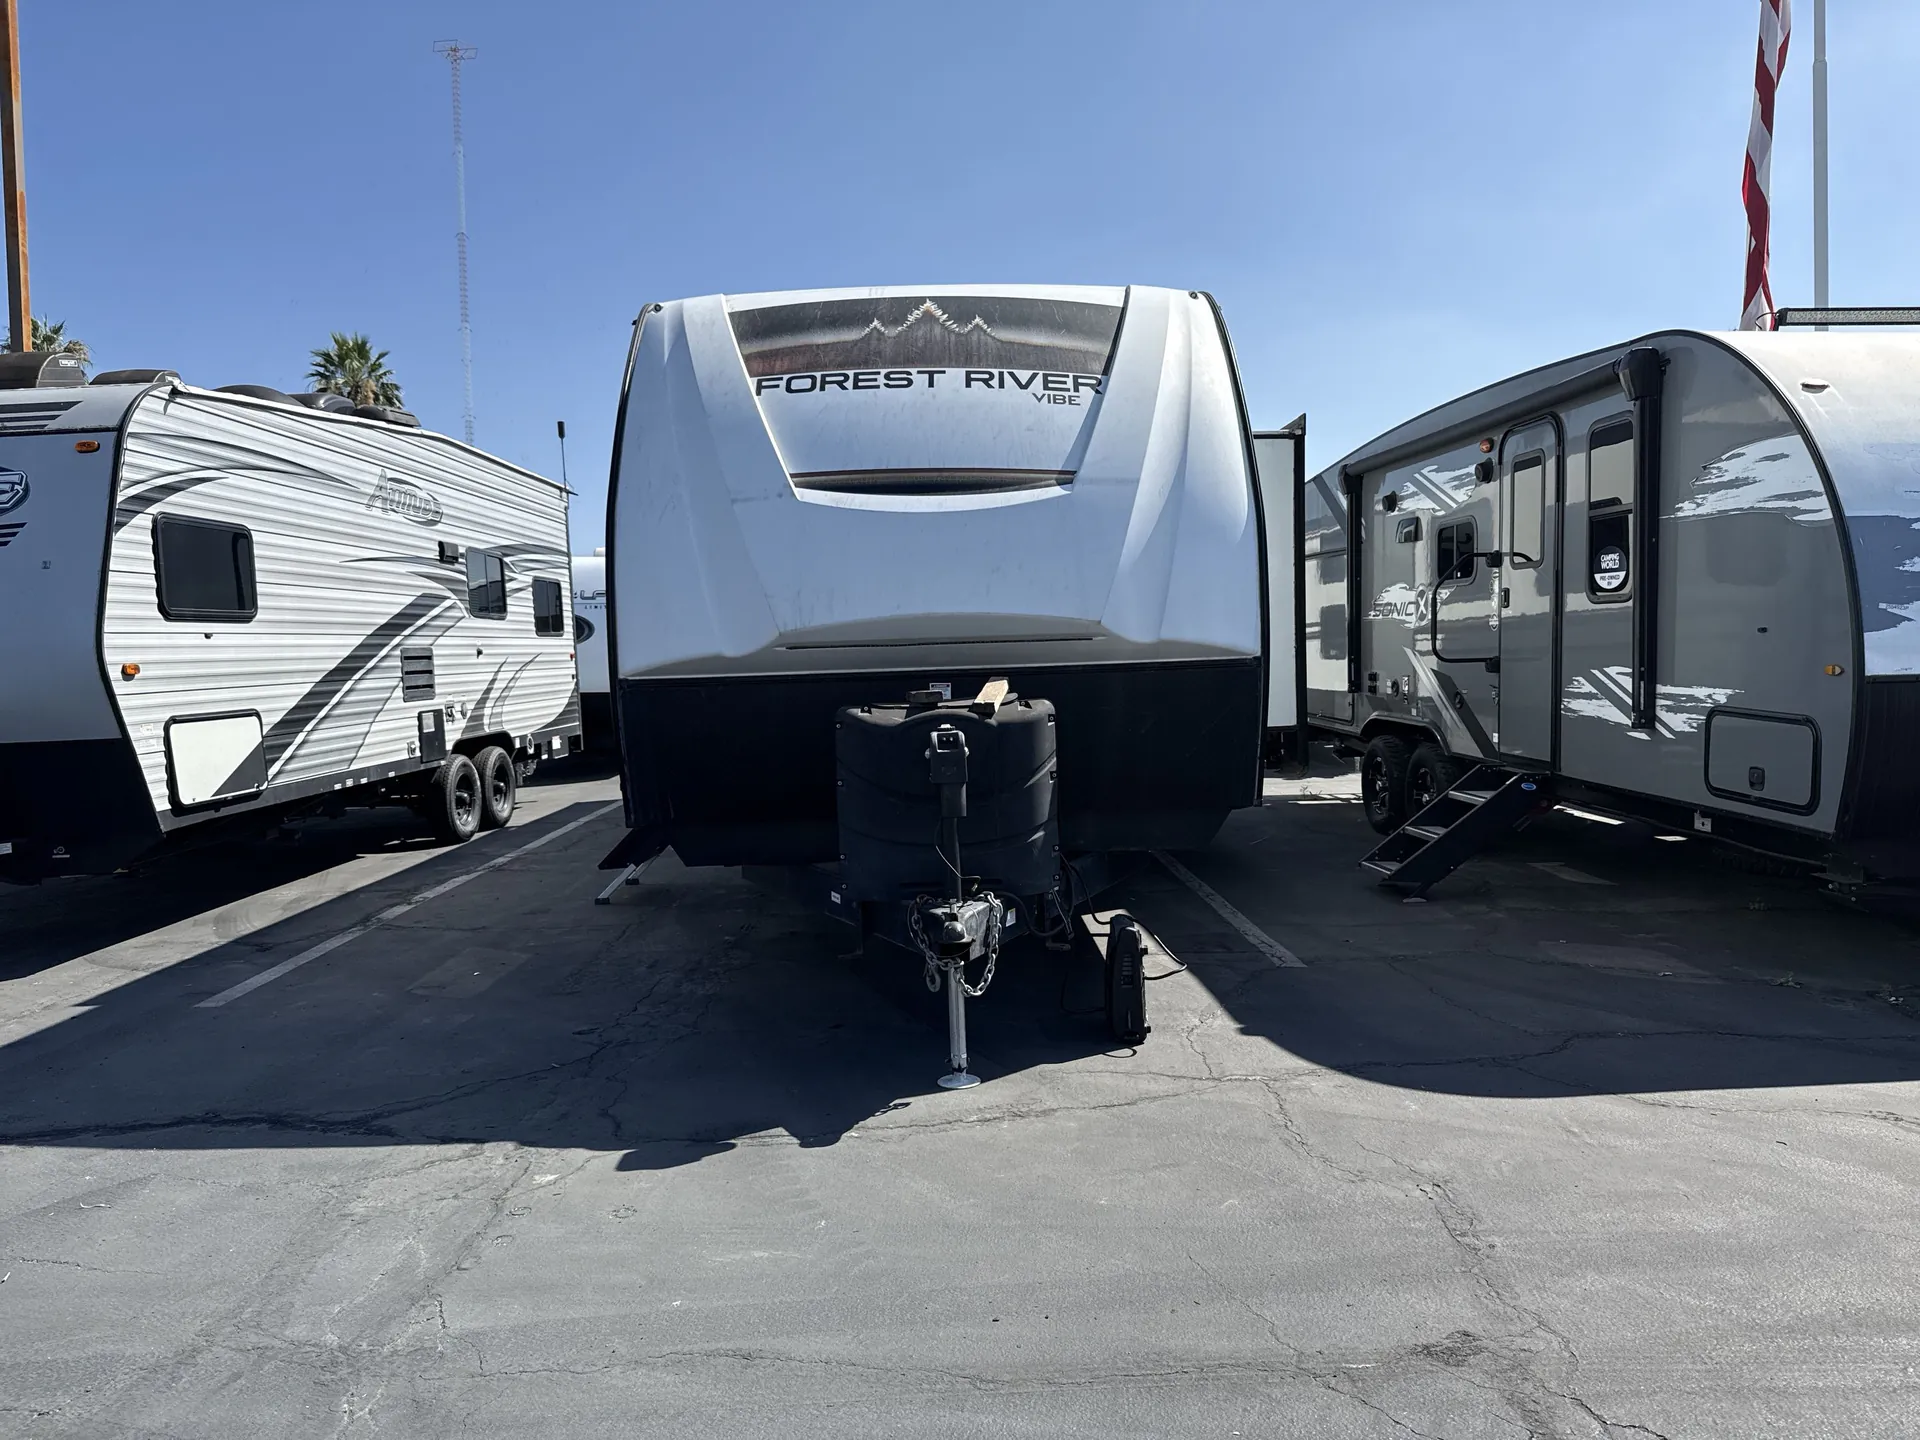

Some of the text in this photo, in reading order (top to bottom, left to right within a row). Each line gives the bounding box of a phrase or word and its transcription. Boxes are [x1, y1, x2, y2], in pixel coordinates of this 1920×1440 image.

[755, 370, 1103, 397] FOREST RIVER
[1031, 393, 1081, 406] VIBE
[1600, 553, 1620, 561] CAMPING
[1600, 560, 1620, 569] WORLD
